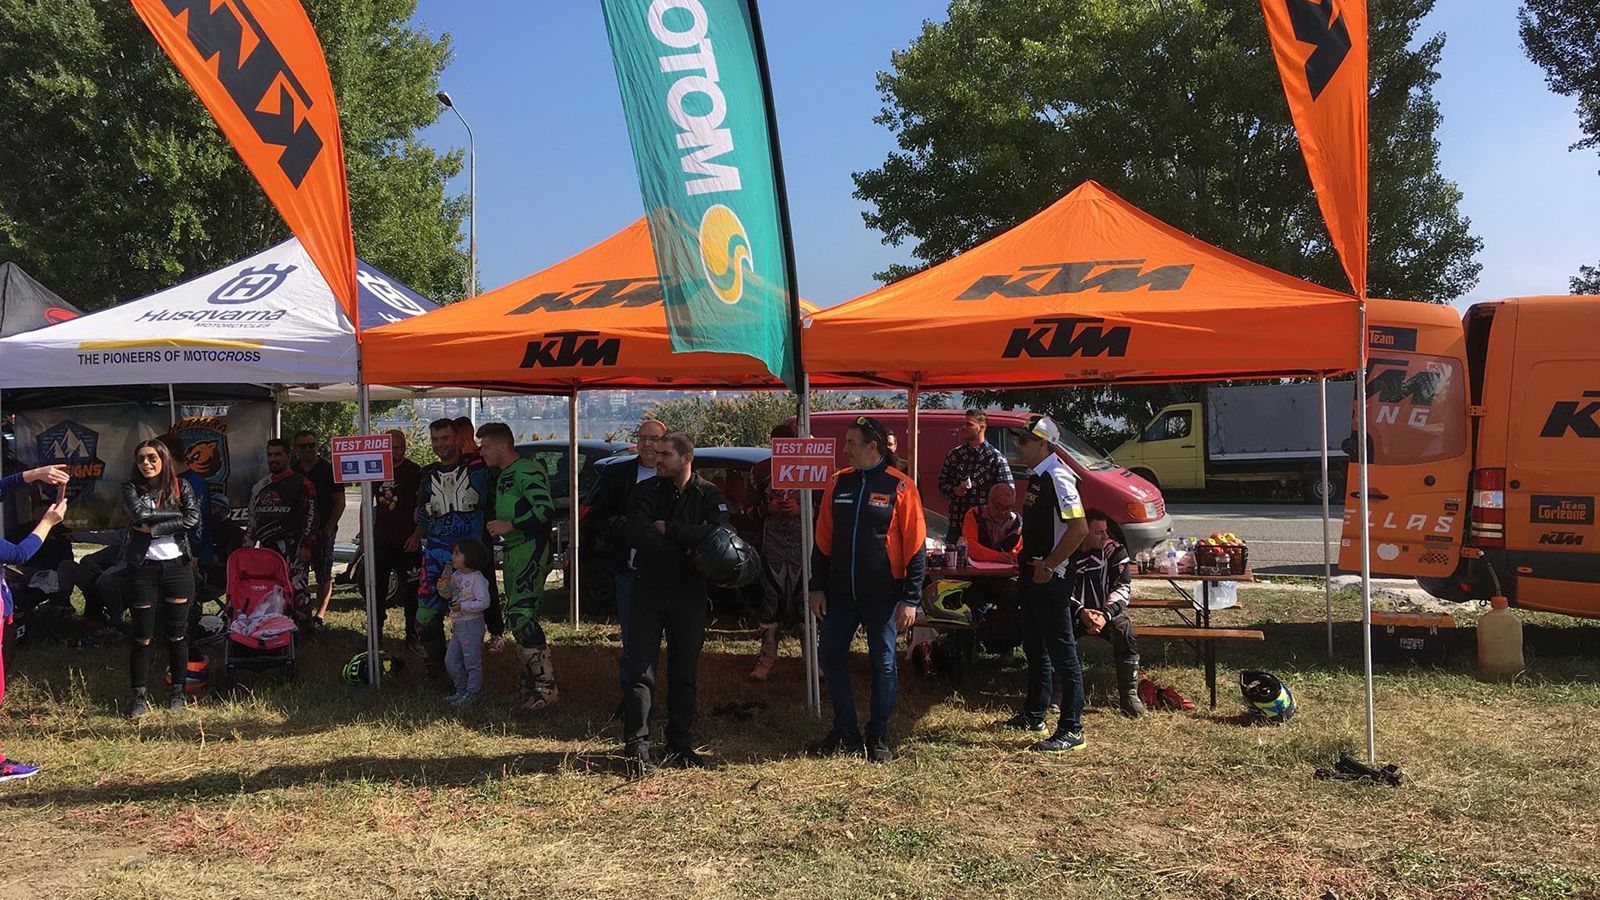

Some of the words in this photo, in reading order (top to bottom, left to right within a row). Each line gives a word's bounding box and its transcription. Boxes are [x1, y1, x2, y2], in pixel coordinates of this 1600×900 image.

[952, 258, 1195, 301] KTM
[135, 309, 287, 323] Husqvarna
[1001, 317, 1132, 359] KTM
[1369, 329, 1395, 345] Team
[519, 330, 621, 369] KTM
[78, 354, 99, 365] THE
[103, 351, 161, 364] PIONEERS
[164, 351, 180, 361] OF
[183, 350, 261, 362] MOTOCROSS
[335, 440, 362, 451] TEST
[364, 438, 389, 449] RIDE
[775, 443, 803, 454] TEST
[806, 443, 833, 454] RIDE
[779, 465, 828, 482] KTM
[1538, 504, 1586, 520] Corleone
[1560, 500, 1586, 510] Team
[1538, 531, 1585, 546] KTM
